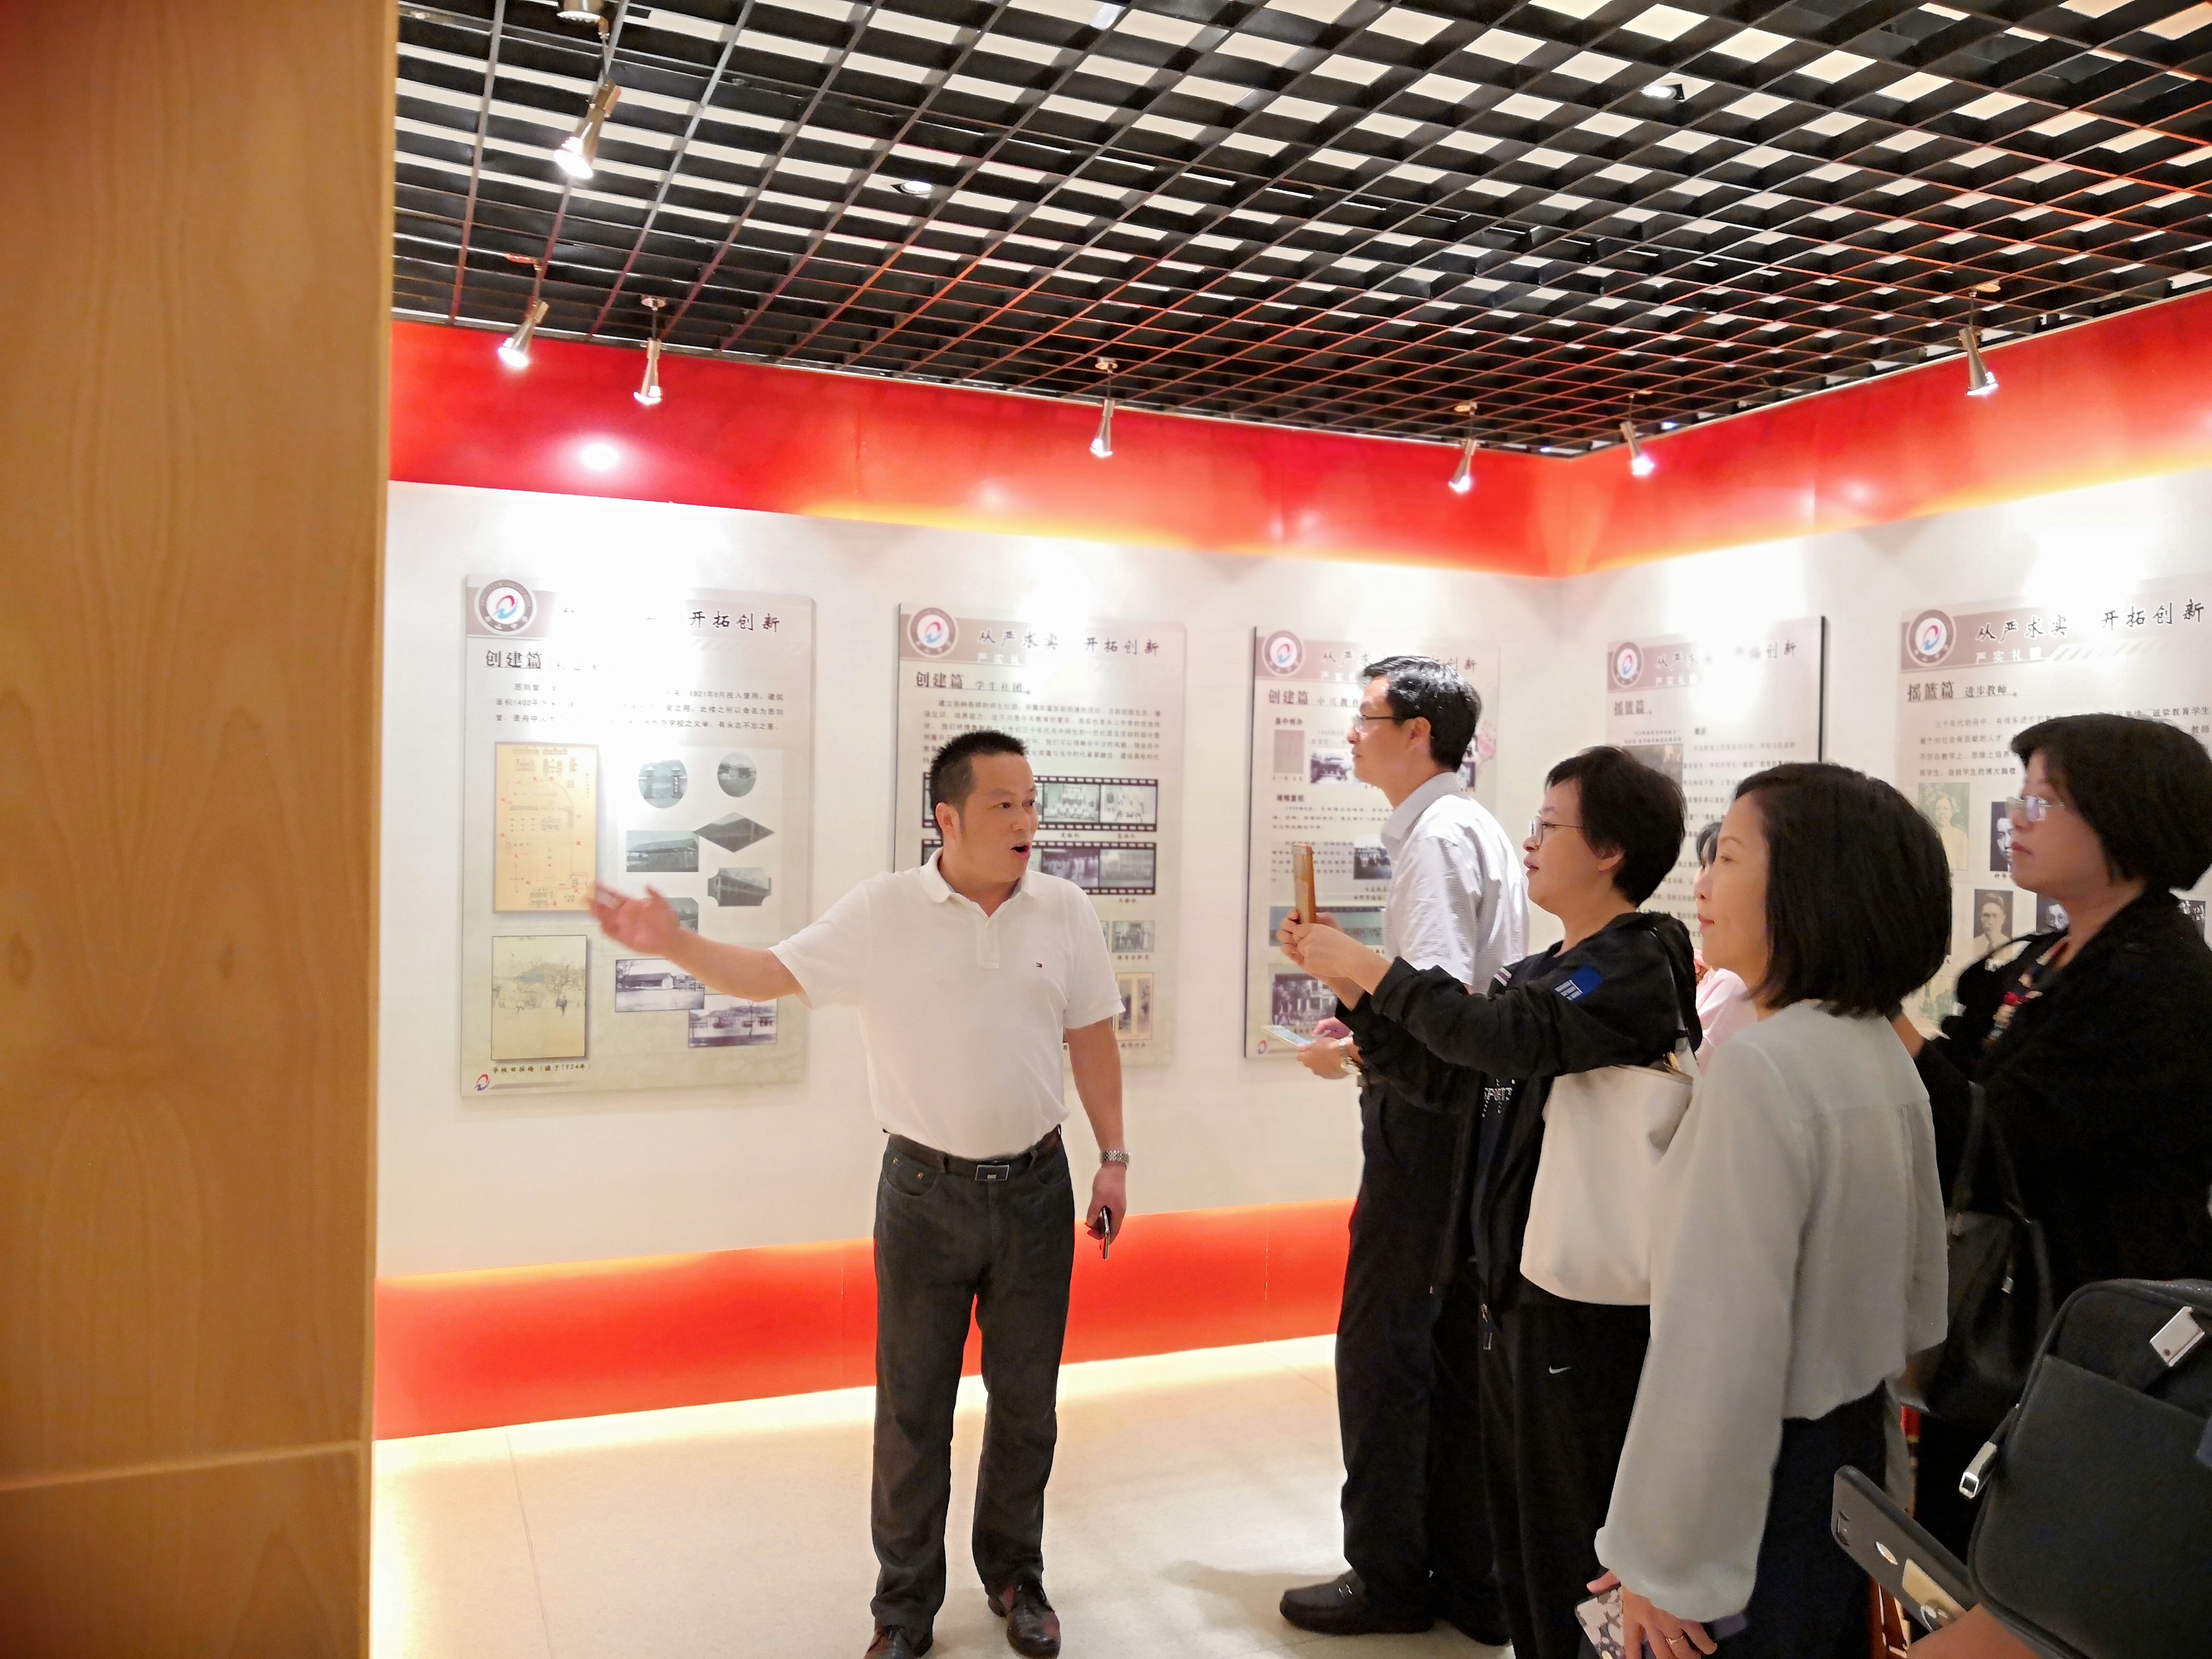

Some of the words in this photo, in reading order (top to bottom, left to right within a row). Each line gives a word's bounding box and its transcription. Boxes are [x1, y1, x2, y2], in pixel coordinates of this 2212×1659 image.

[688, 611, 780, 632] 开拓创新
[1975, 614, 2068, 643] 从严求实
[2101, 599, 2205, 630] 开拓创新
[978, 629, 1058, 650] 从严求实
[1084, 637, 1160, 657] 开拓创新
[485, 650, 542, 669] 创建篇
[916, 672, 964, 689] 创建篇
[974, 680, 1023, 692] 学生社团
[1965, 684, 2007, 697] 进步教师
[1269, 689, 1309, 705] 创建篇
